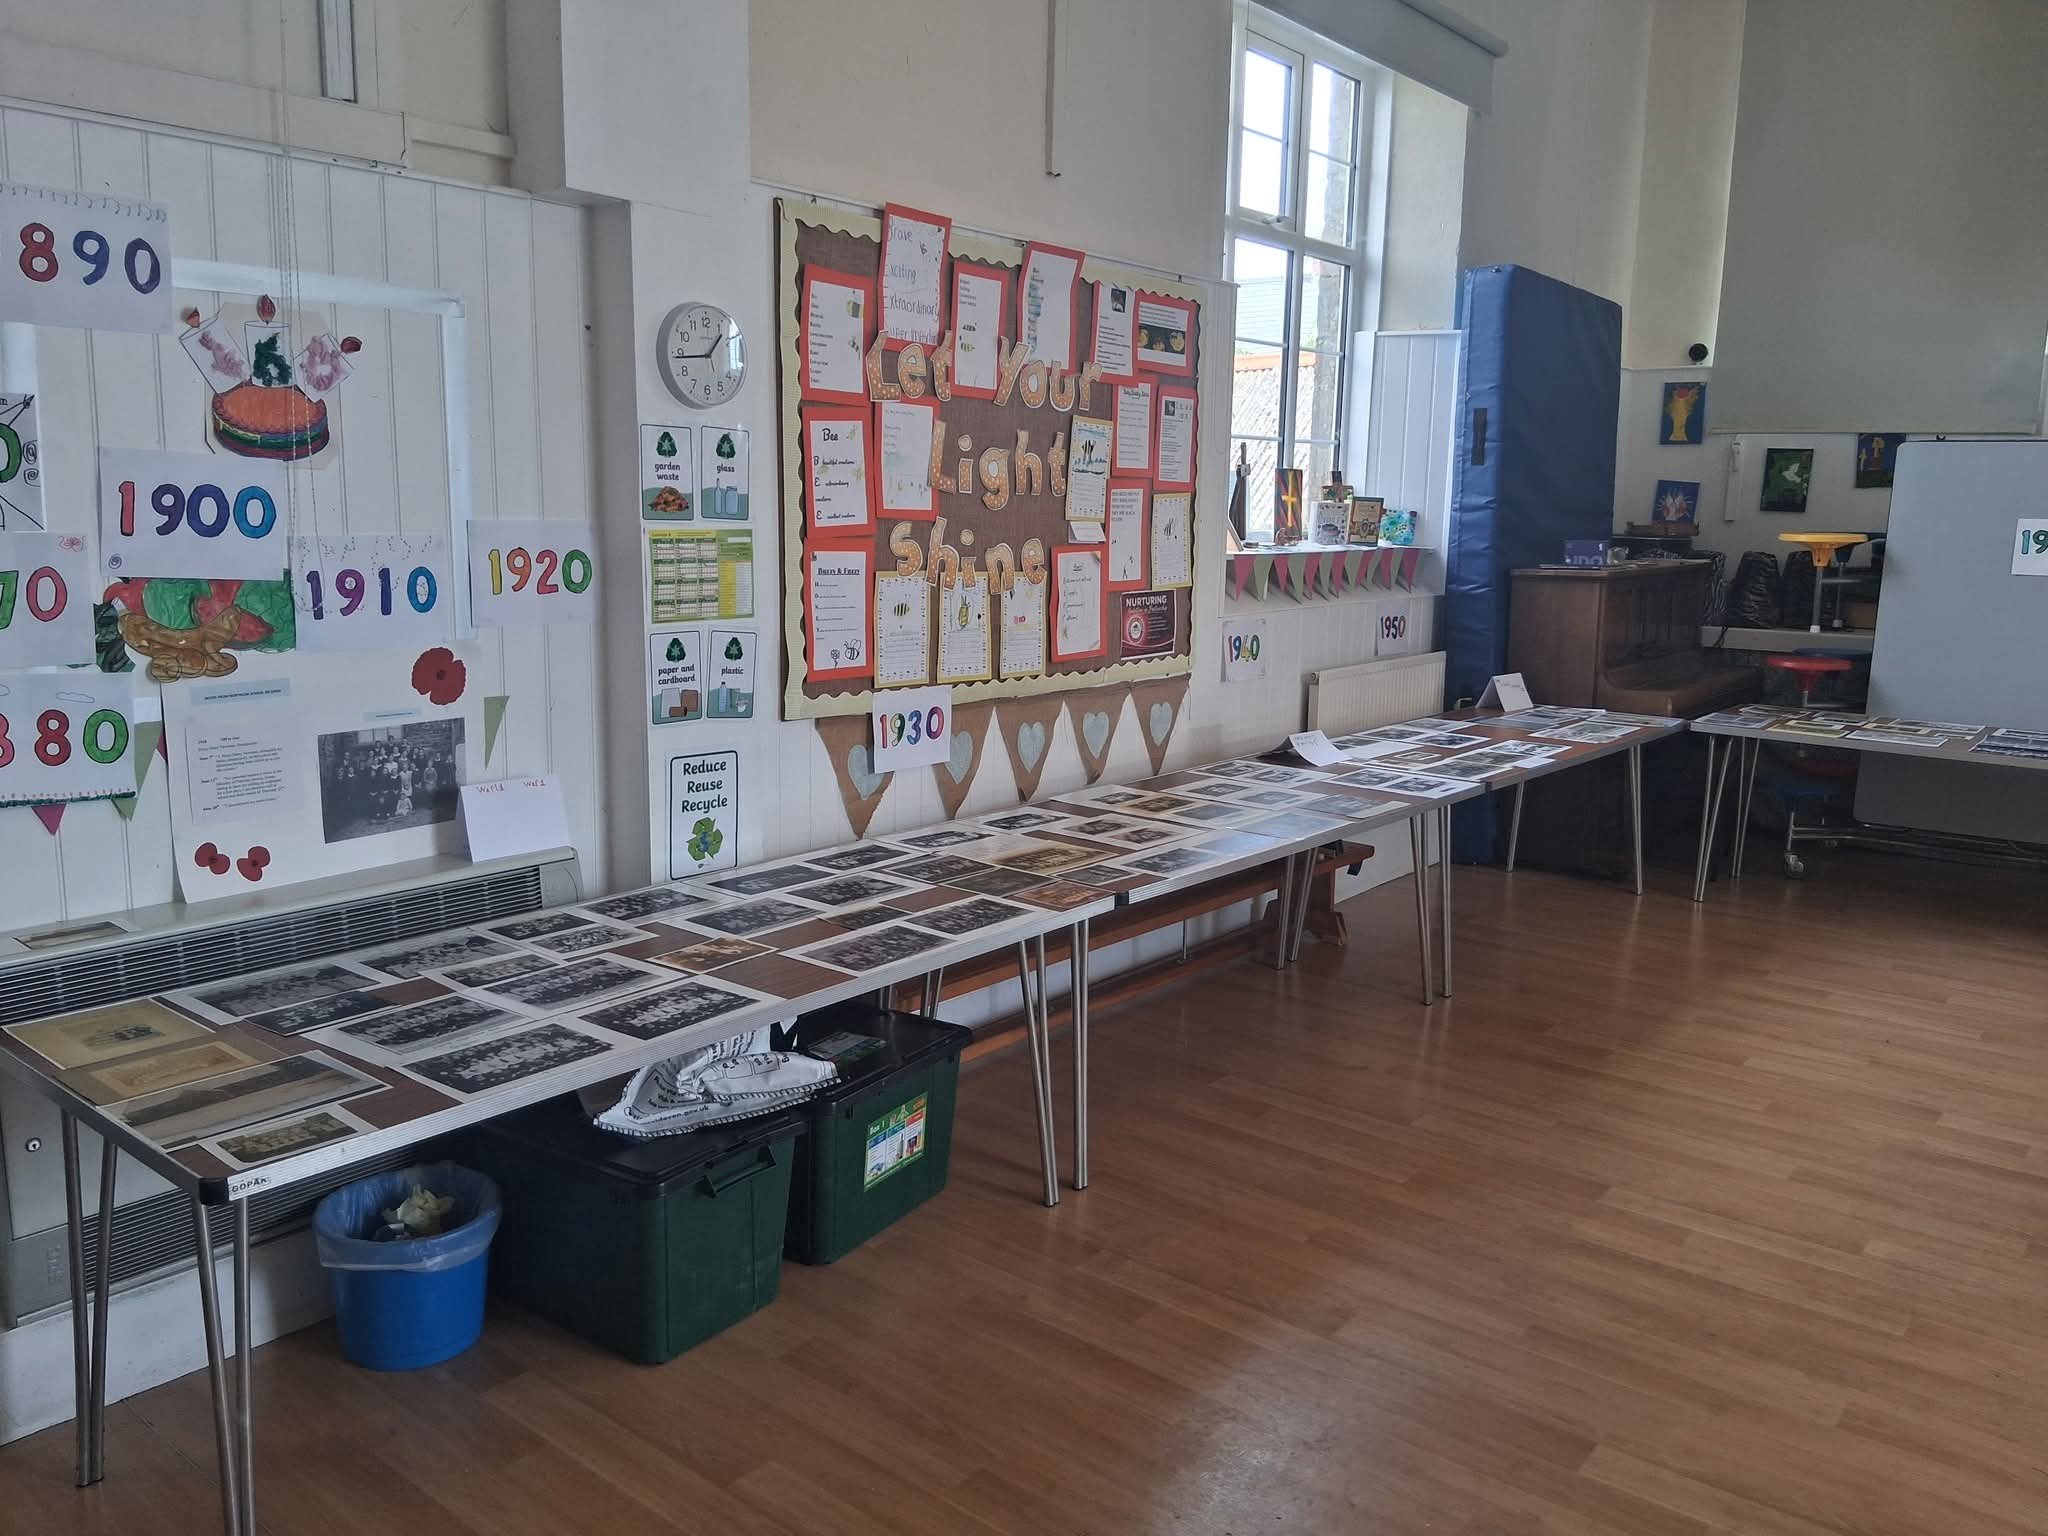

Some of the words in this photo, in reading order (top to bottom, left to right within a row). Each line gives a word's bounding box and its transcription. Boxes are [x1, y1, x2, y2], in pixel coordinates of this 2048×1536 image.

[689, 319, 697, 331] 11
[701, 316, 711, 329] 12
[679, 331, 690, 343] 10
[681, 366, 689, 377] 8
[866, 330, 952, 402] Let
[691, 378, 698, 389] 7
[704, 384, 711, 395] 6
[717, 381, 724, 392] 5
[821, 427, 839, 442] Bee
[654, 461, 681, 472] garden
[716, 463, 735, 473] glass
[929, 420, 1066, 511] Light
[656, 471, 680, 481] waste
[118, 480, 277, 539] 1900
[488, 546, 593, 595] 1920
[306, 566, 438, 620] 1910
[1126, 595, 1167, 608] NURTURING
[1380, 615, 1406, 640] 1950
[1227, 634, 1260, 662] 1940
[657, 665, 679, 677] paper
[681, 663, 695, 673] and
[720, 665, 744, 676] plastic
[657, 674, 696, 685] cardboard
[879, 705, 945, 750] 1930
[682, 759, 727, 776] Reduce
[687, 777, 723, 794] Reuse
[681, 794, 728, 814] Recycle
